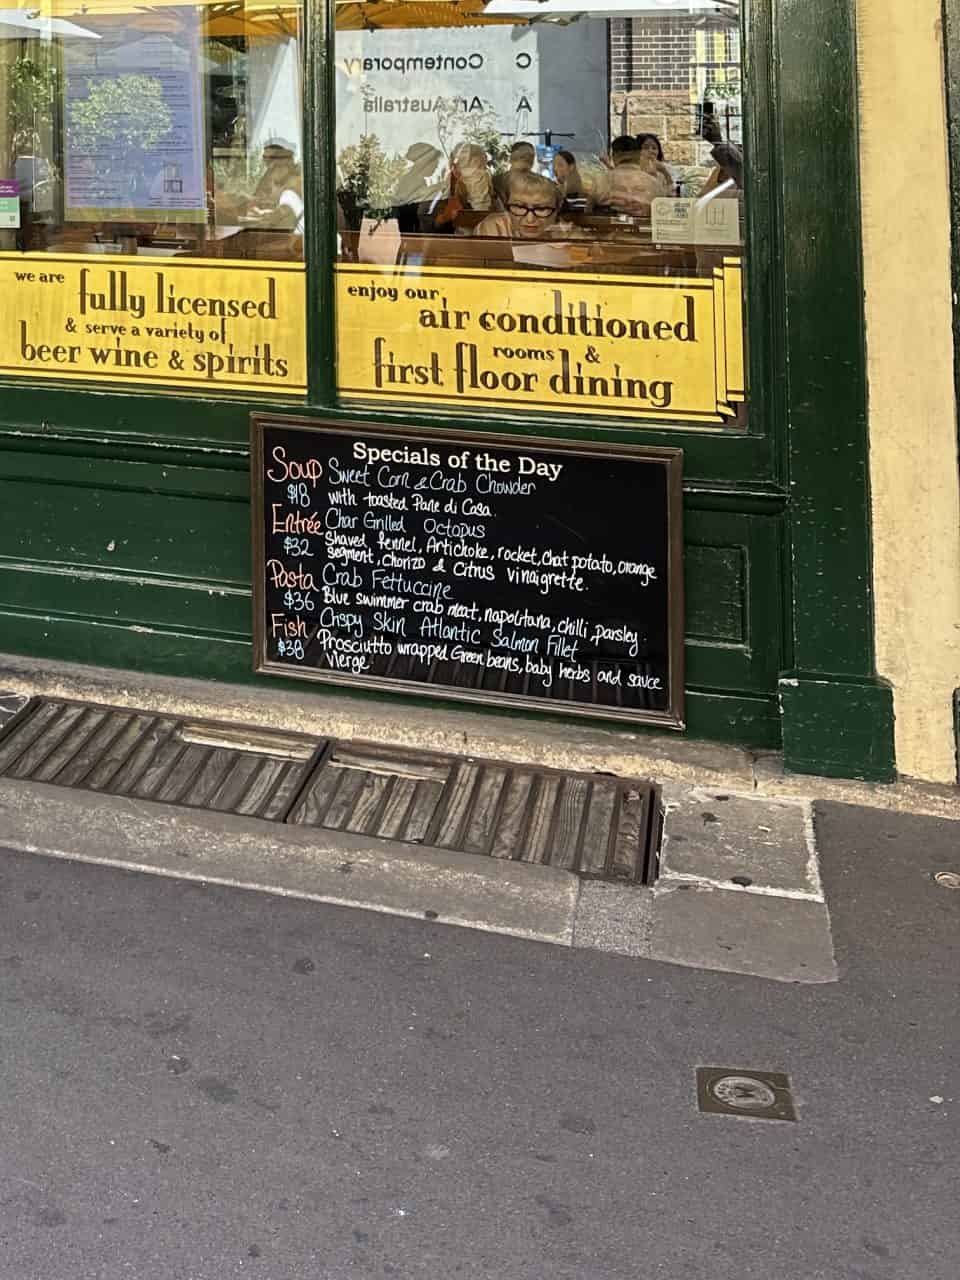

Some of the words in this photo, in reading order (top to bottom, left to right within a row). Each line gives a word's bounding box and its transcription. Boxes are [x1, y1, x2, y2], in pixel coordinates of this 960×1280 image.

[14, 271, 36, 283] we
[38, 272, 65, 283] are
[347, 280, 399, 301] enjoy
[404, 286, 440, 301] our
[78, 268, 145, 319] fully
[154, 272, 278, 320] licensed
[419, 297, 471, 330] air
[478, 289, 698, 342] conditioned
[65, 317, 78, 334] &
[85, 323, 127, 336] serve
[131, 325, 141, 337] a
[145, 321, 204, 343] variety
[209, 317, 227, 344] of
[19, 319, 81, 363] beer
[88, 336, 158, 369] wine
[168, 349, 185, 371] &
[193, 343, 288, 379] spirits
[493, 346, 555, 361] rooms
[585, 345, 600, 363] &
[373, 337, 444, 388] first
[453, 342, 538, 394] floor
[549, 349, 673, 407] dining
[267, 446, 322, 488] Soup
[353, 442, 440, 466] Specials
[448, 451, 470, 469] of
[475, 453, 511, 472] the
[518, 456, 563, 481] Day
[328, 457, 371, 487] Sweet
[476, 472, 536, 495] Chowder
[287, 483, 310, 507] $18
[328, 488, 358, 506] with
[363, 491, 408, 511] toasted
[363, 511, 406, 533] Grilled
[423, 518, 486, 539] Octopus
[284, 536, 314, 557] $32
[266, 559, 319, 592] Pasta
[322, 562, 362, 588] Crab
[372, 569, 455, 600] Fettuccine
[283, 588, 315, 611] $36
[321, 585, 351, 605] Blue
[271, 613, 308, 639] Fish
[373, 611, 406, 637] Skin
[419, 615, 481, 644] Atlantic
[278, 637, 305, 660] $38
[316, 628, 392, 655] Prosciutto
[397, 642, 448, 665] wrapped
[597, 669, 622, 687] and
[626, 673, 664, 690] sauce
